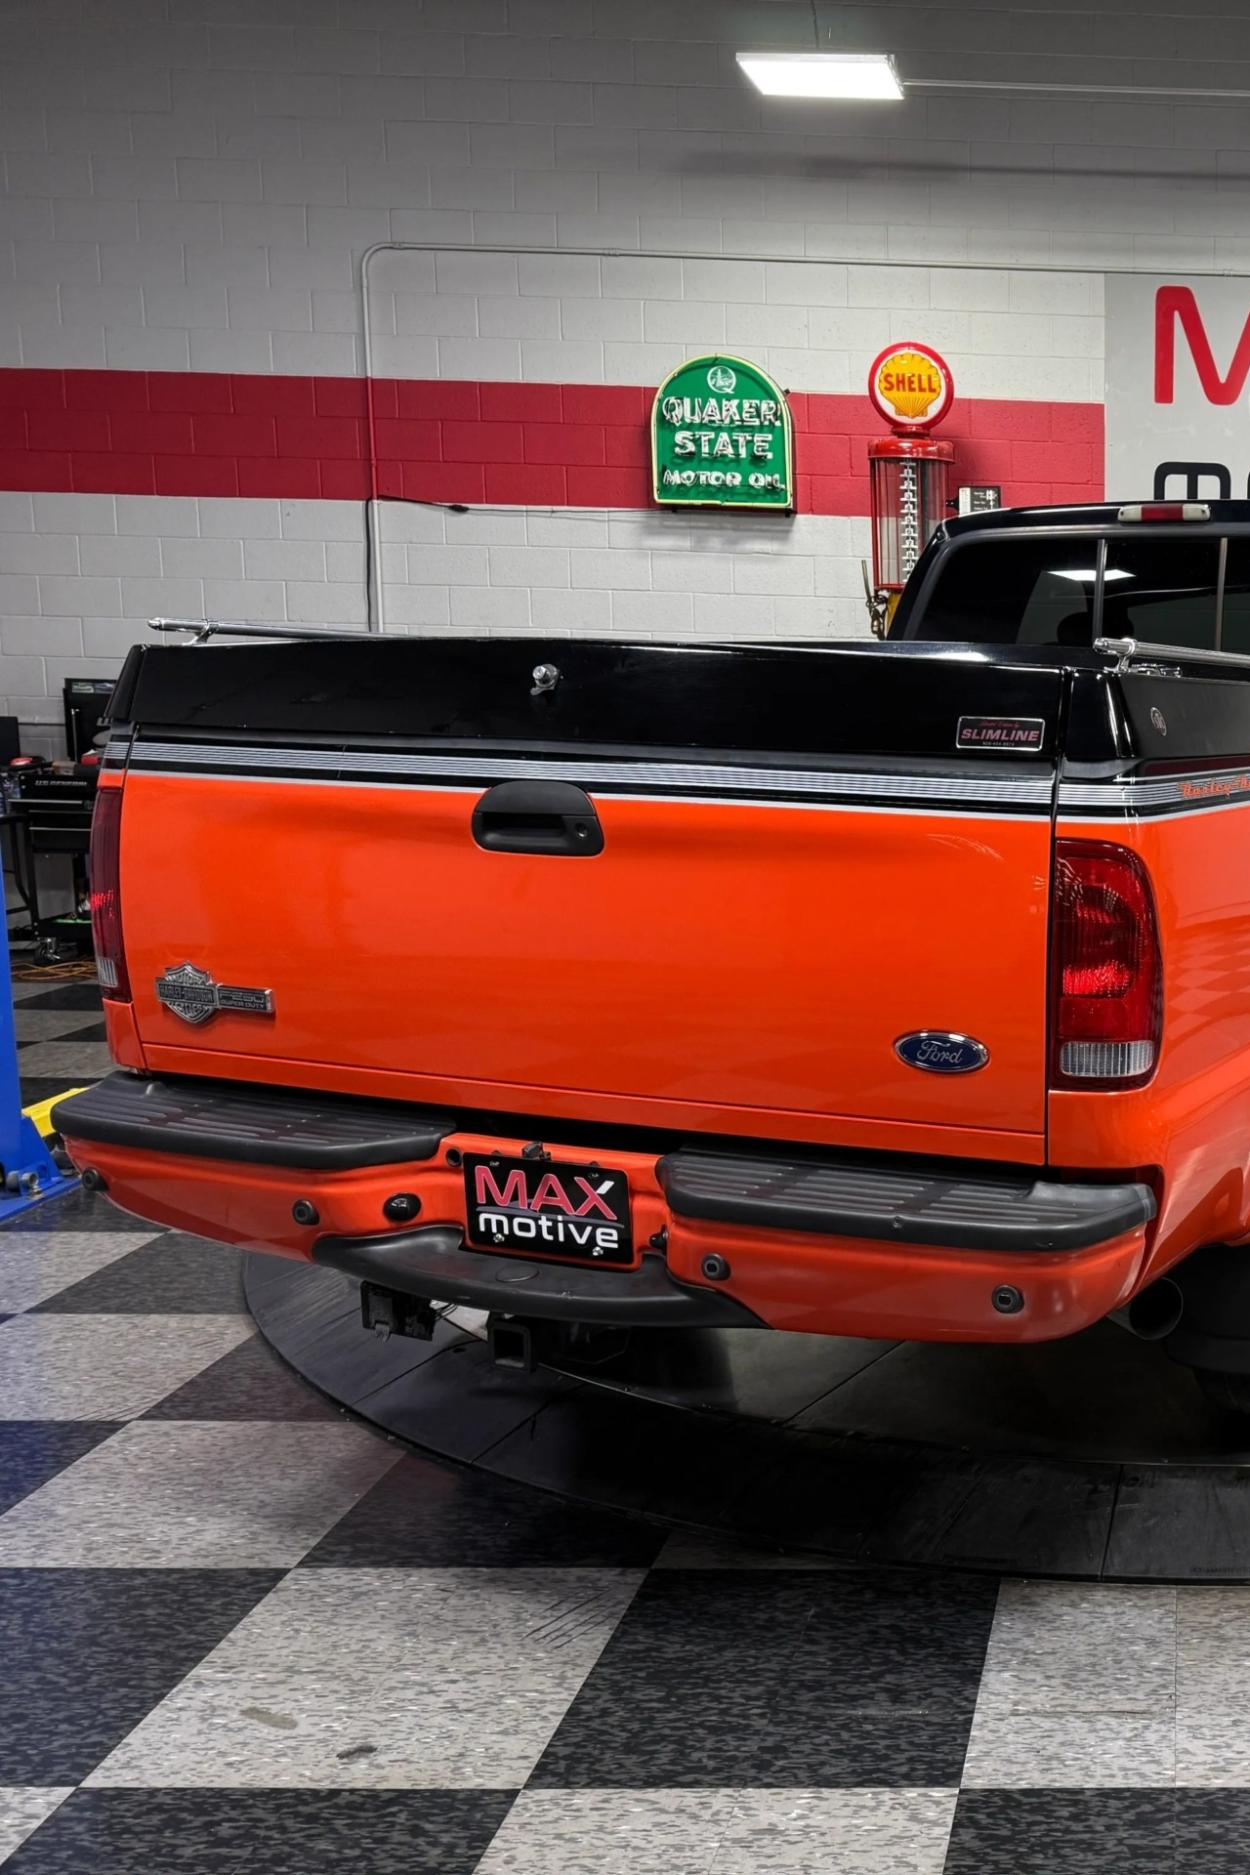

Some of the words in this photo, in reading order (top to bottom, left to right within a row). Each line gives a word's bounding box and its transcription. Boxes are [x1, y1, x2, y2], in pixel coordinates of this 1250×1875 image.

[884, 373, 937, 393] SHELL
[662, 397, 782, 427] QUAKER
[674, 430, 774, 459] STATE
[663, 469, 742, 487] MOTOR
[749, 472, 786, 490] OIL
[961, 728, 1040, 742] SLIMLINE
[917, 1040, 963, 1063] Ford
[474, 1165, 618, 1220] MAX
[478, 1212, 619, 1248] motive
